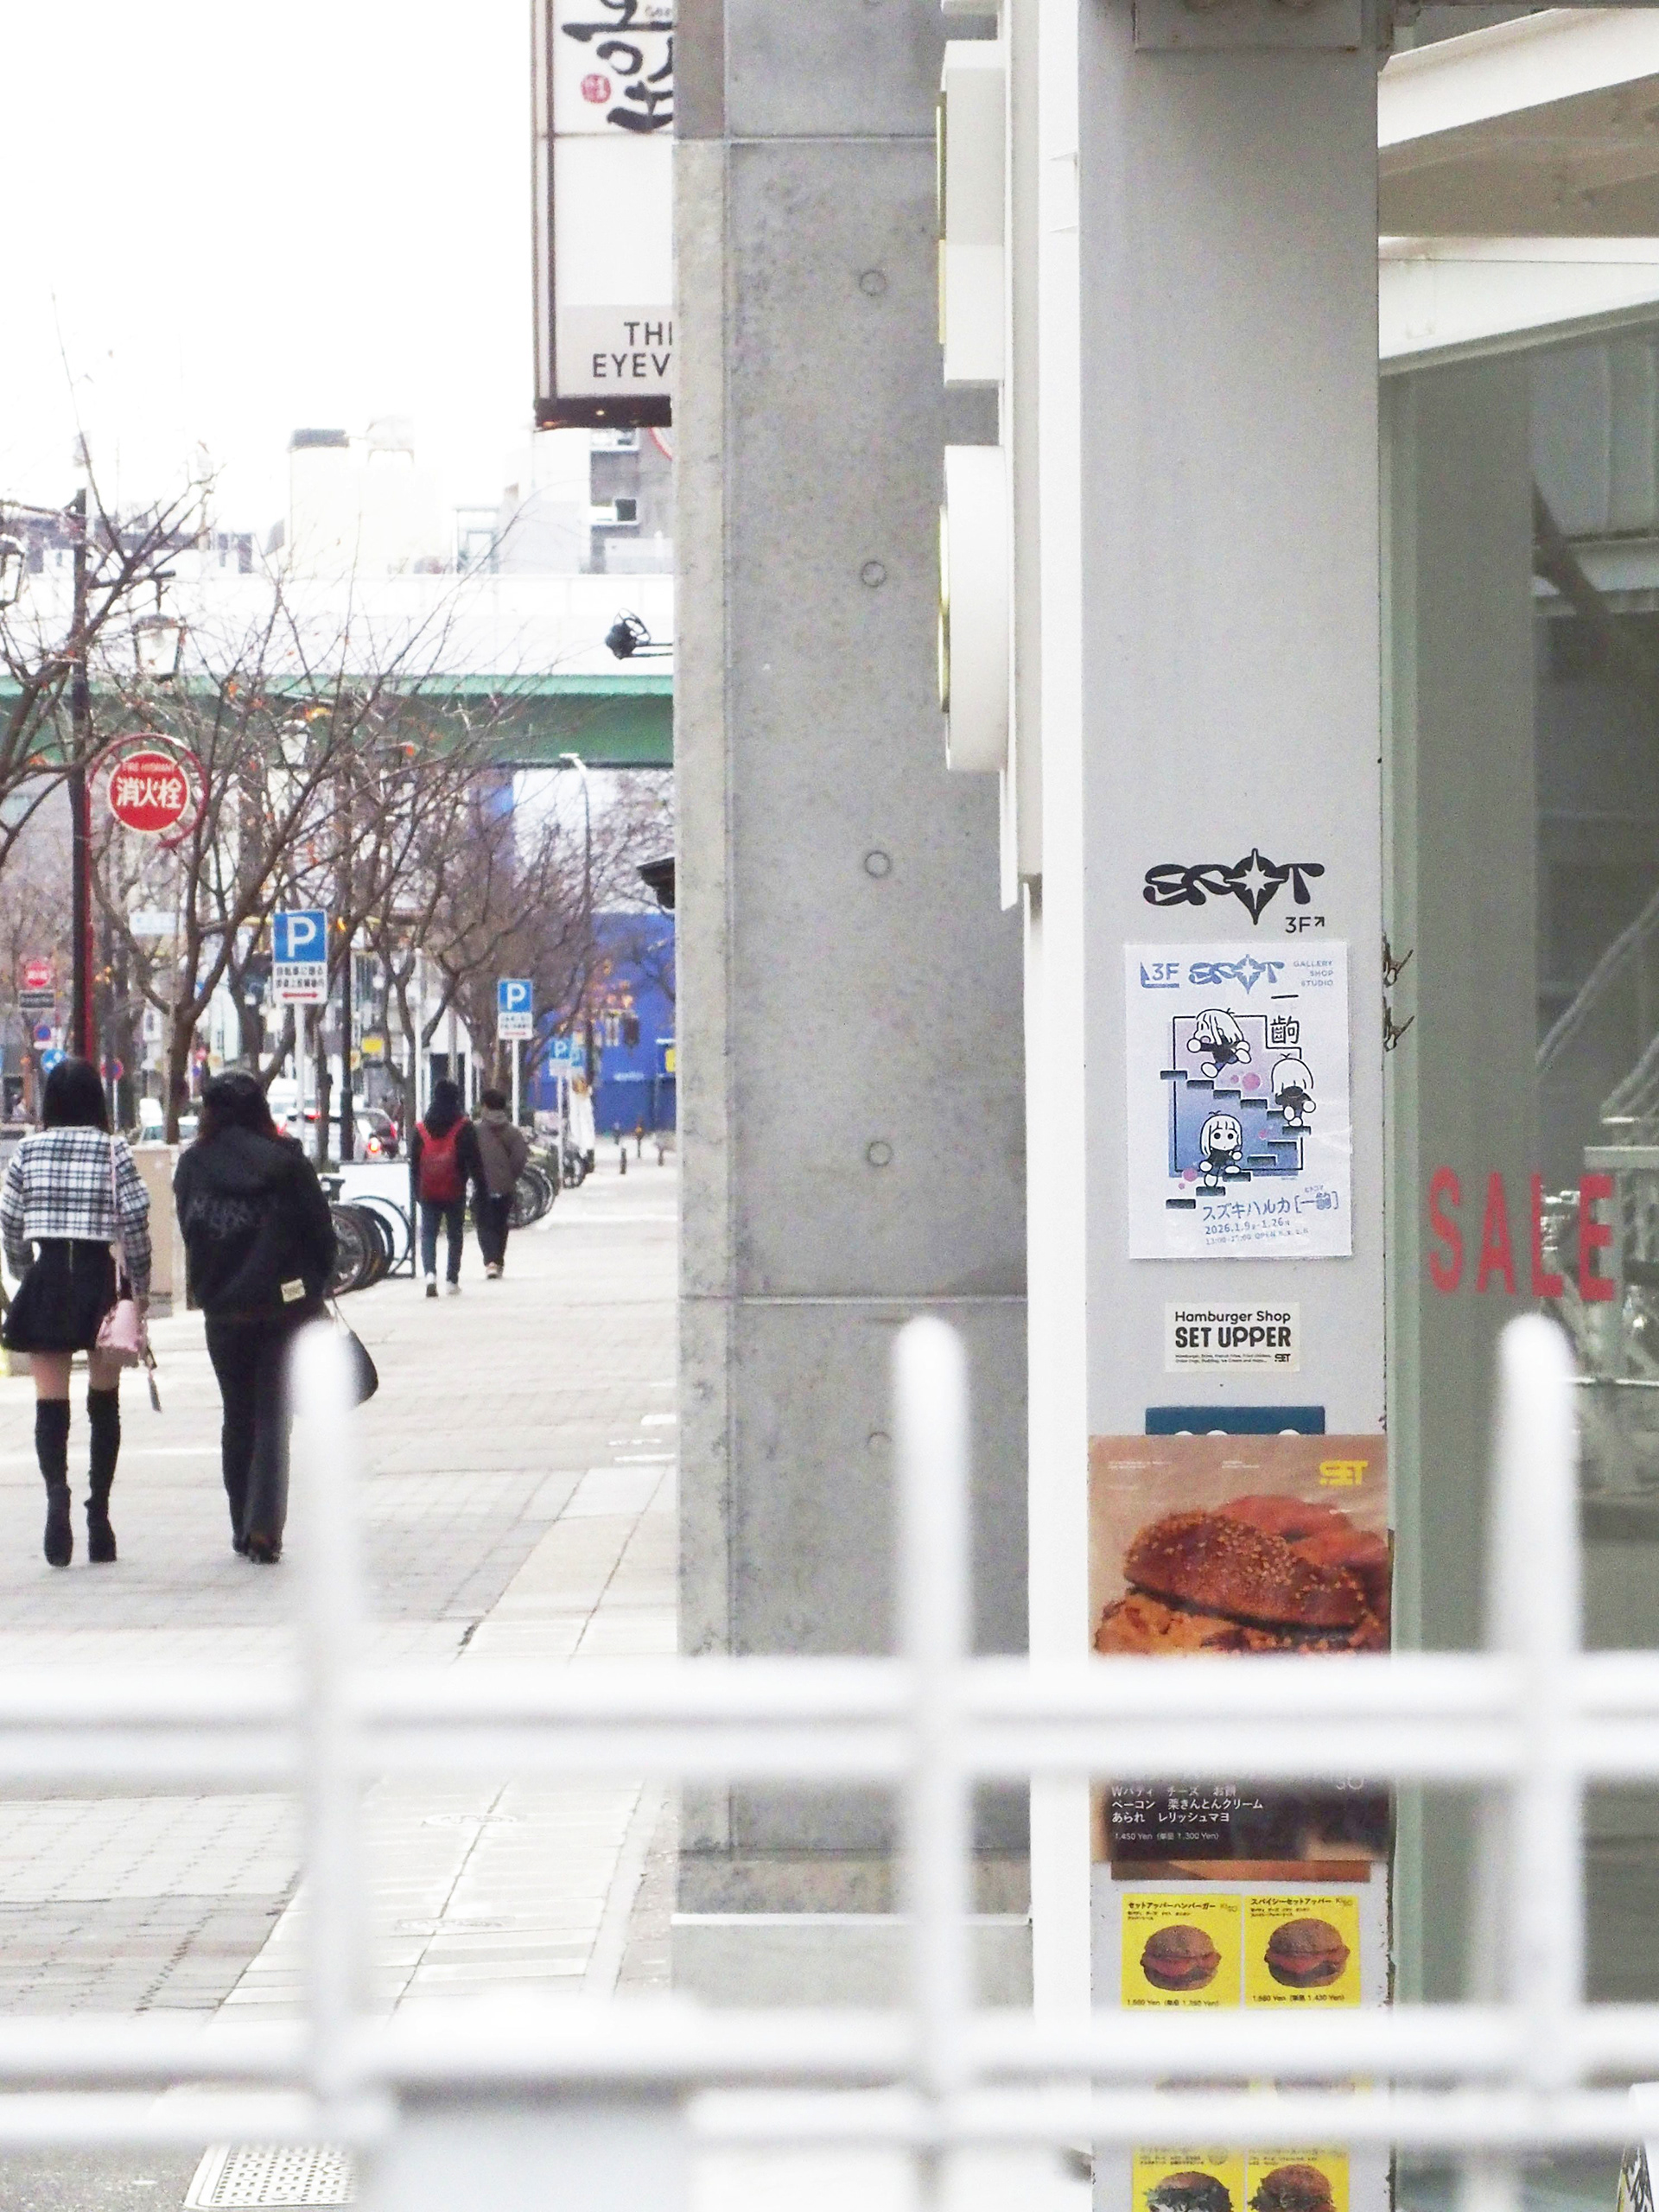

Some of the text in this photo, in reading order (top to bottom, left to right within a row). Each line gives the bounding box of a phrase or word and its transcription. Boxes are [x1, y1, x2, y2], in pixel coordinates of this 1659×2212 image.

[593, 353, 671, 378] EYEV
[117, 777, 182, 808] 消火栓
[1285, 916, 1312, 933] 3F
[287, 916, 316, 957] P
[1152, 963, 1179, 981] 3F
[506, 982, 526, 1010] P
[1427, 1165, 1615, 1301] SALE
[1175, 1310, 1291, 1325] Hamburger Shop
[1175, 1325, 1292, 1348] SET UPPER
[1274, 1353, 1292, 1363] SET
[1319, 1460, 1369, 1486] SET
[1111, 1812, 1230, 1823] あられ レリッシュマヨ
[1137, 1832, 1154, 1840] Yen
